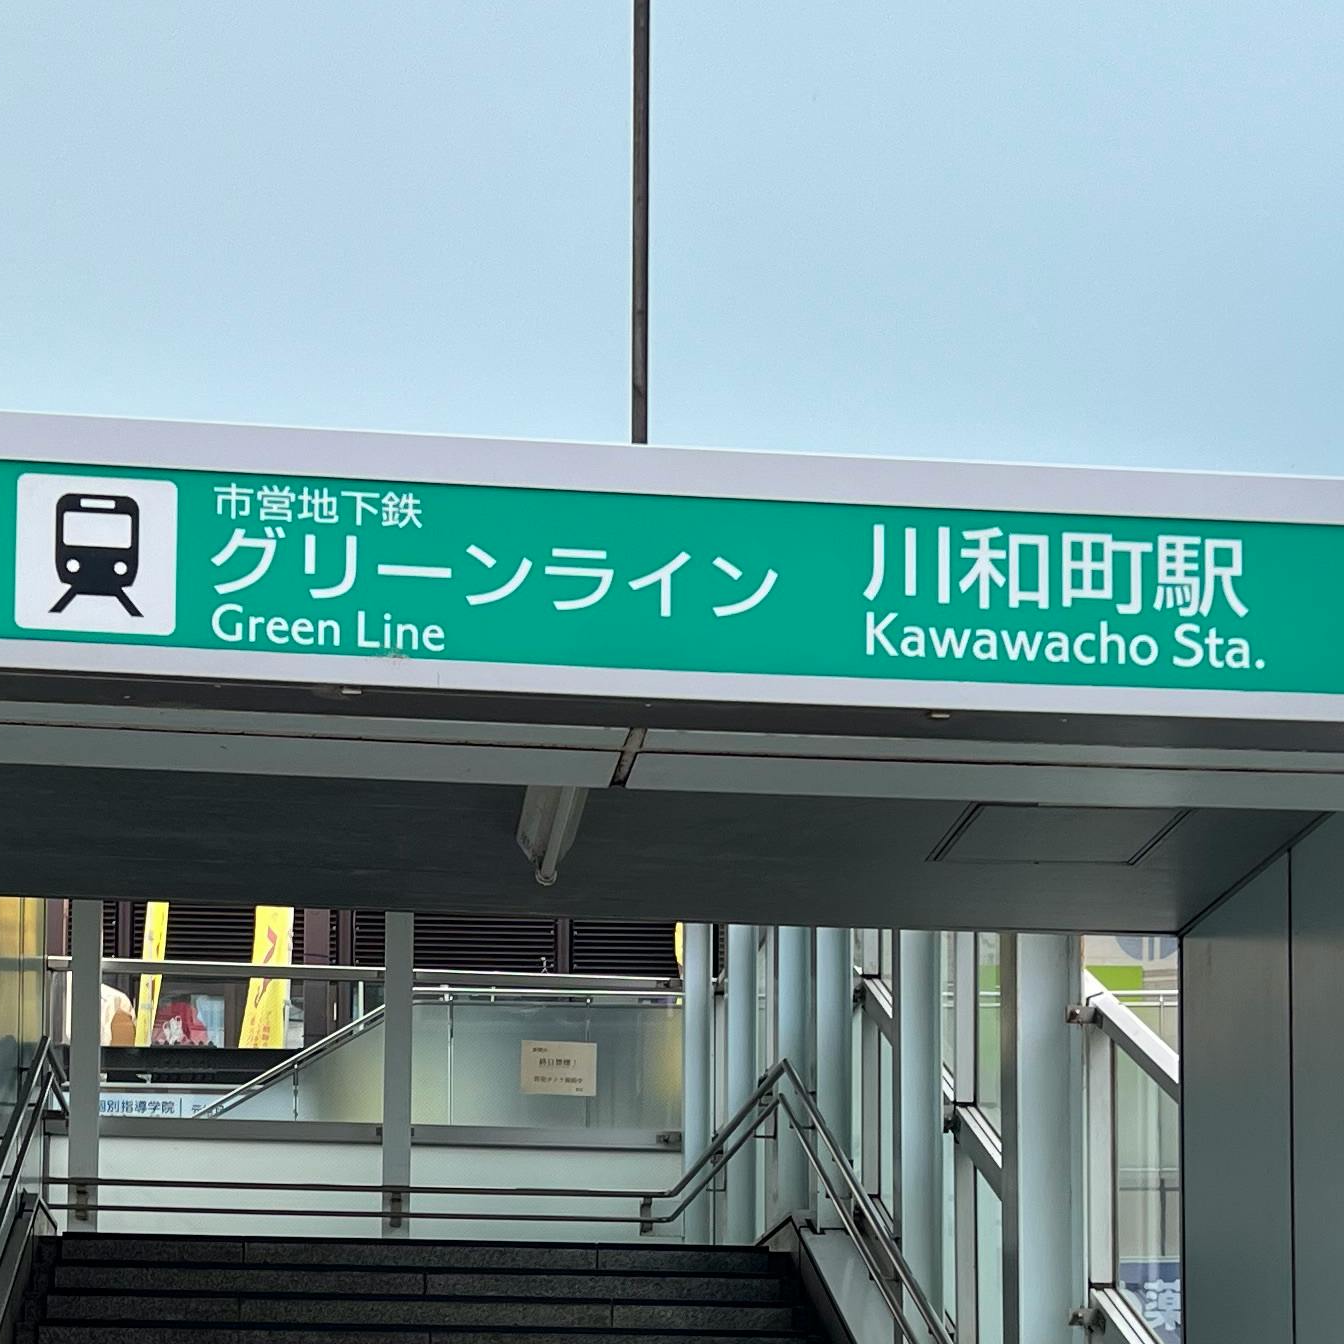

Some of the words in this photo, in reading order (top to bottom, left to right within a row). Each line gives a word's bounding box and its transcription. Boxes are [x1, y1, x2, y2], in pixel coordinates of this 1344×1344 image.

[213, 483, 424, 529] 市営地下鉄
[210, 526, 780, 618] グリーンライン
[863, 523, 1250, 618] 川和町駅
[211, 605, 342, 648] Green
[357, 611, 446, 653] Line
[866, 612, 1159, 666] Kawawacho
[1173, 624, 1265, 669] Sta.
